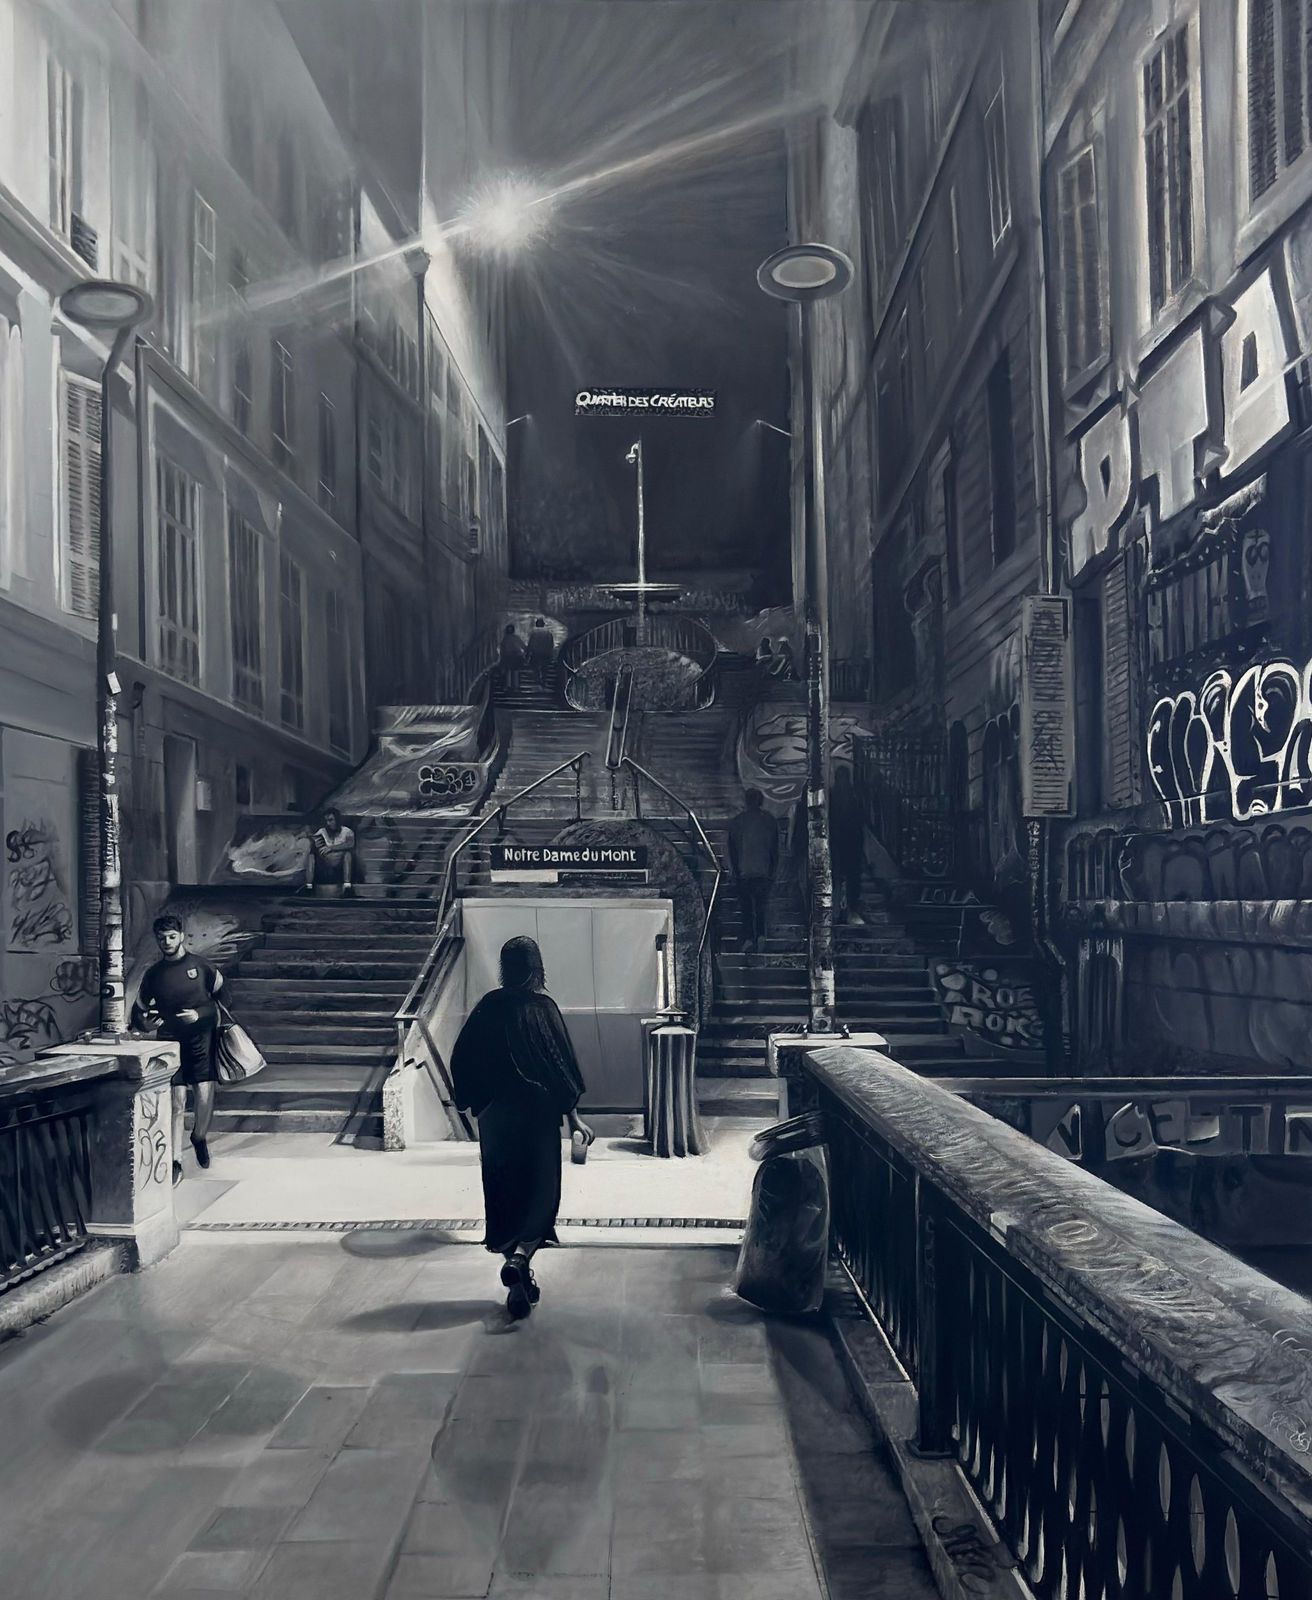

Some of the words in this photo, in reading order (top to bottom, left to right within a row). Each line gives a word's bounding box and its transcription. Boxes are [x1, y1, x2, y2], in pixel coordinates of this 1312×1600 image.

[628, 396, 649, 408] DES
[504, 848, 541, 862] Notre
[543, 849, 580, 862] Dame
[581, 847, 599, 862] du
[601, 849, 637, 862] Mont
